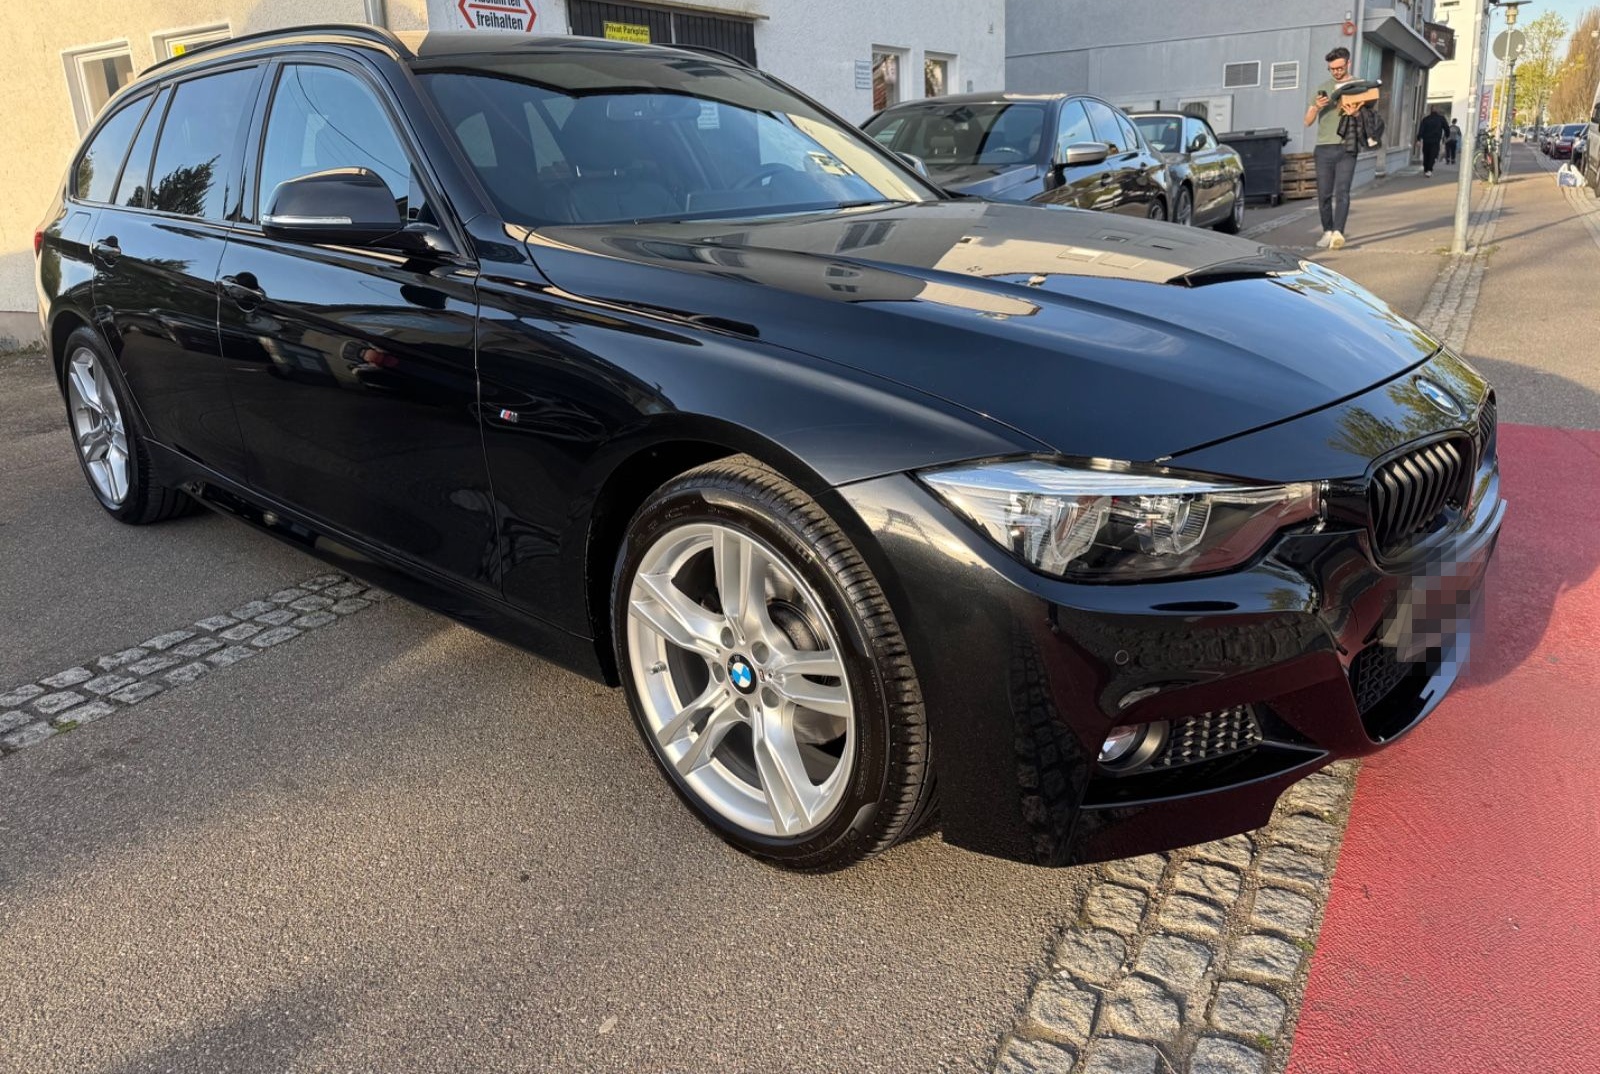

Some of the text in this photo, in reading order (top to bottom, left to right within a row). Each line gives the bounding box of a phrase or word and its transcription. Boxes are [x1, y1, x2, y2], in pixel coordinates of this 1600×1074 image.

[476, 10, 523, 30] freihalten
[605, 23, 649, 37] Privat Parkplatz
